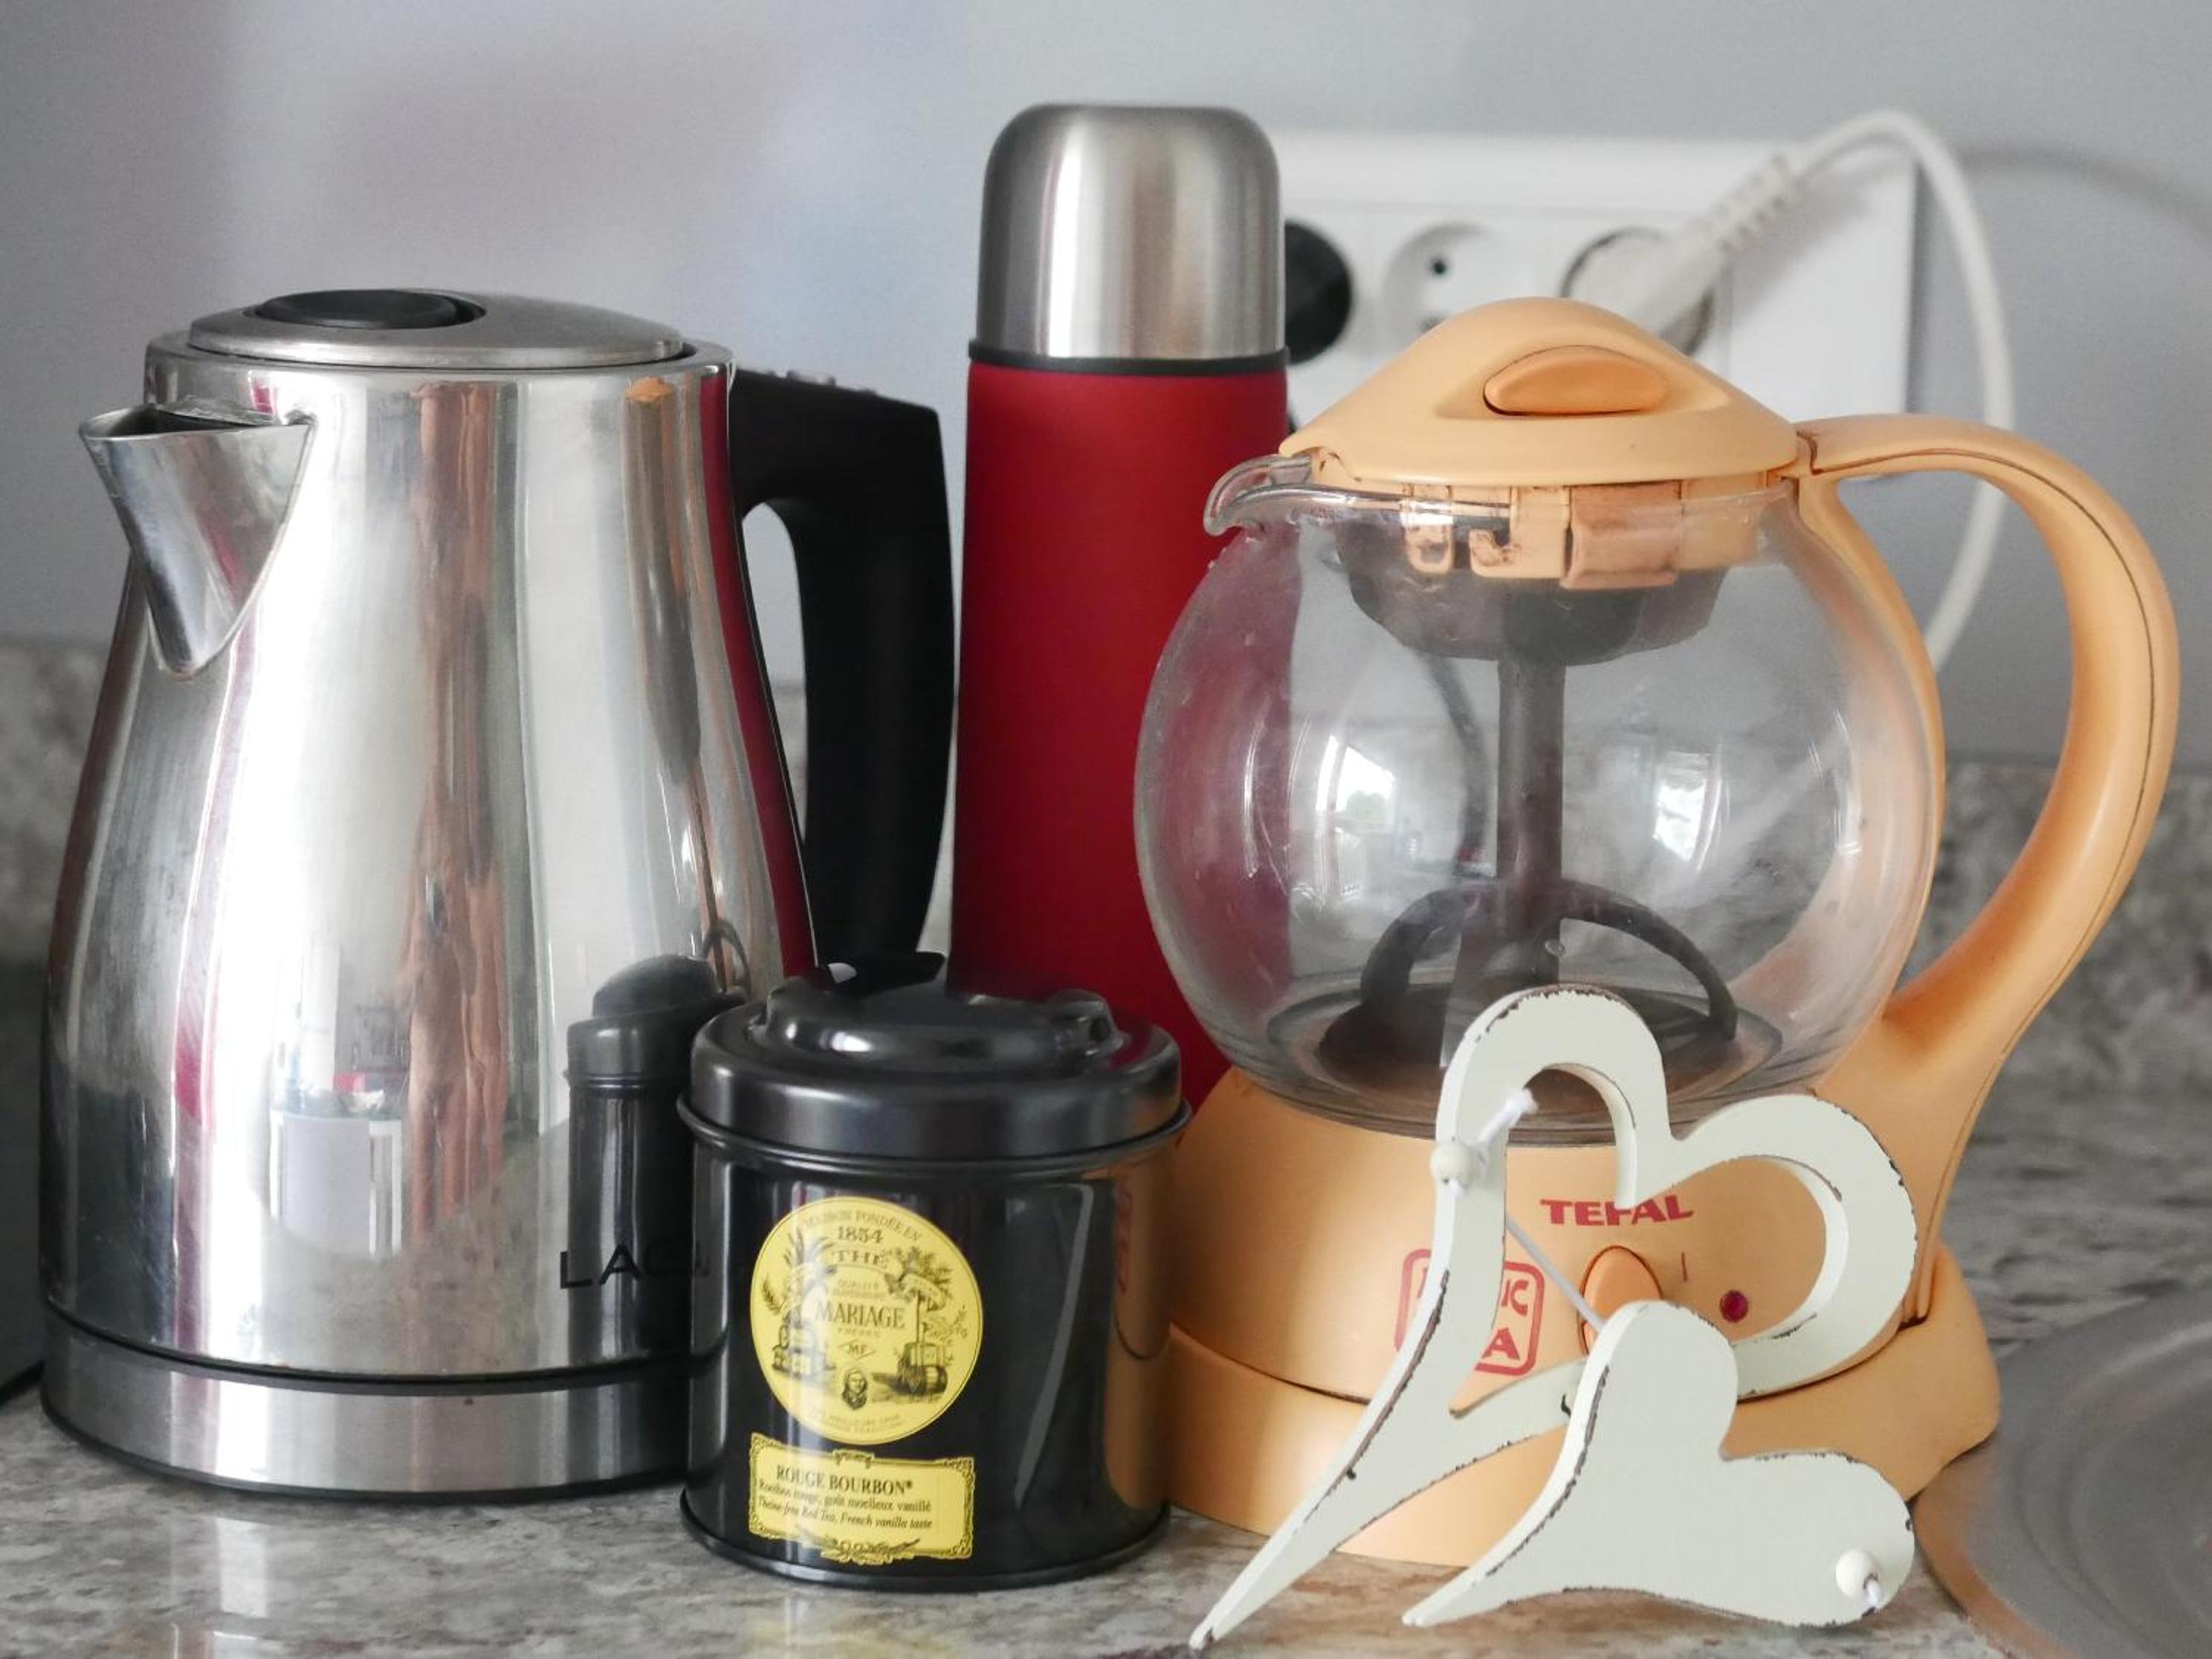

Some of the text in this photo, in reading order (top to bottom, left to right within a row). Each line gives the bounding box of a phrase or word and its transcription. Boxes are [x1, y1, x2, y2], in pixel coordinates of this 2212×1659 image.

[1540, 1194, 1694, 1226] TEFAL
[838, 1226, 884, 1244] 1854
[815, 1300, 905, 1329] MARIAGE
[776, 1464, 825, 1488] ROUGE
